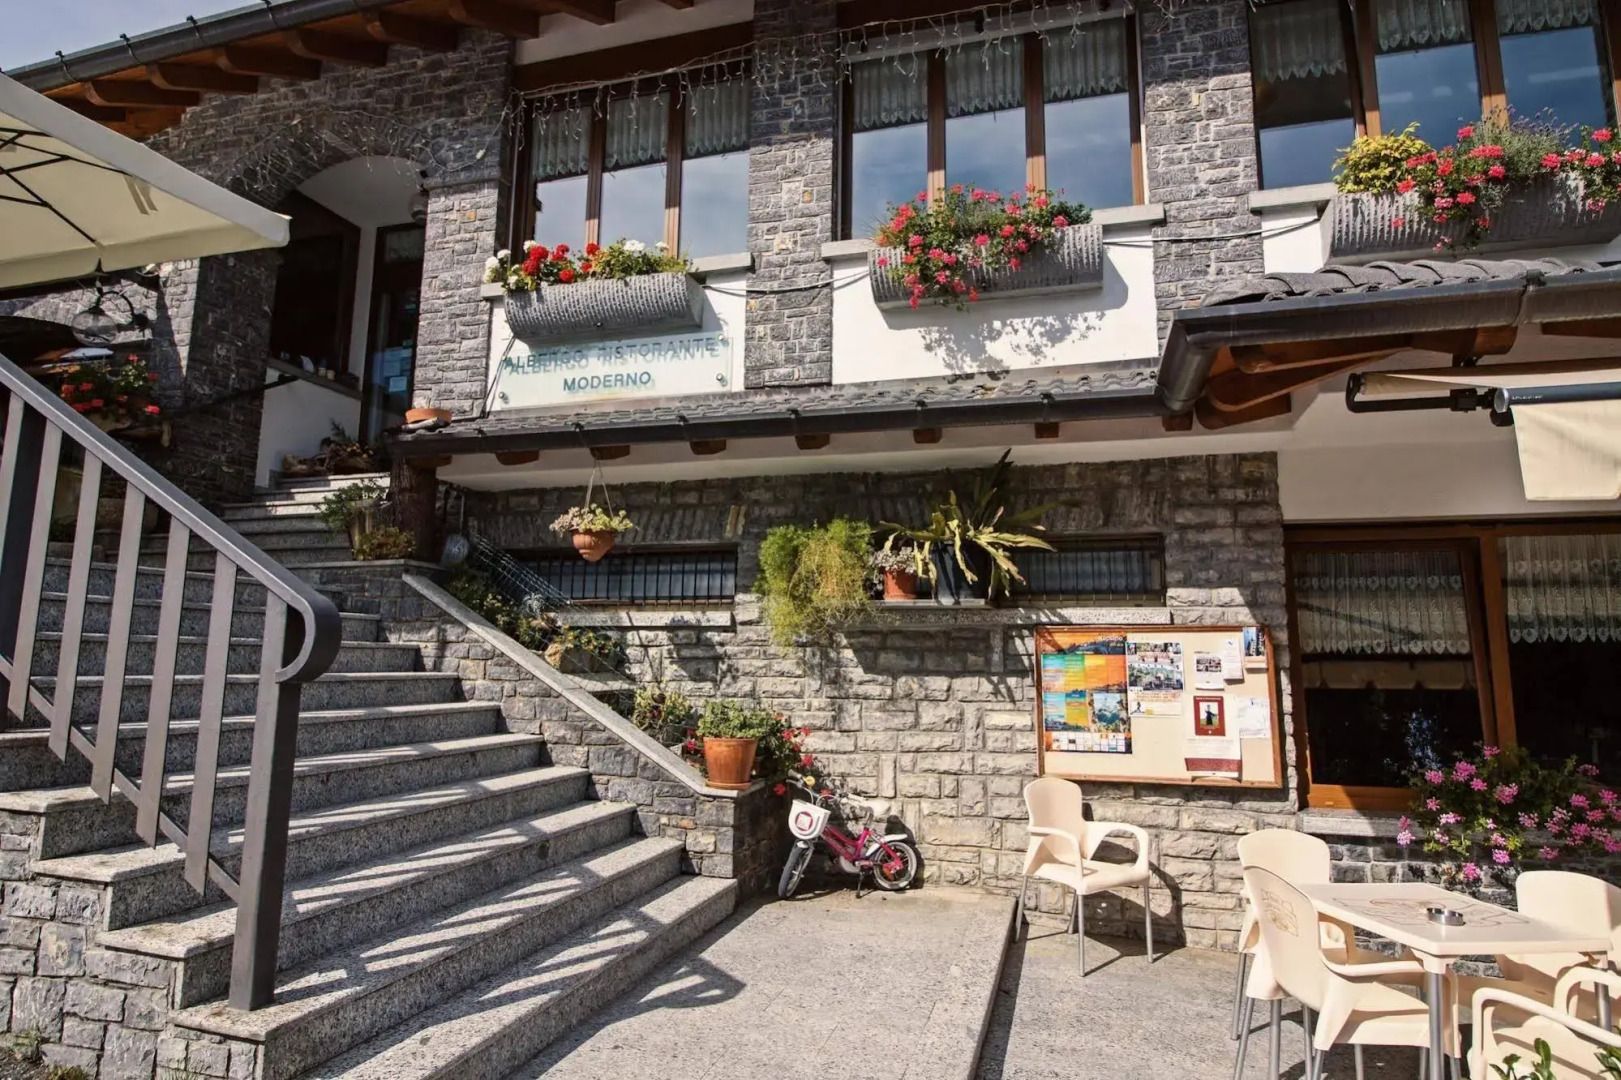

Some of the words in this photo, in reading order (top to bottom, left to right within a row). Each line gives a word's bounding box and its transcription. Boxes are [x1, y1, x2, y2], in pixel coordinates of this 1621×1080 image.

[504, 349, 584, 370] ALBERGO
[597, 337, 718, 361] RISTORANTE
[563, 371, 651, 391] MODERNO
